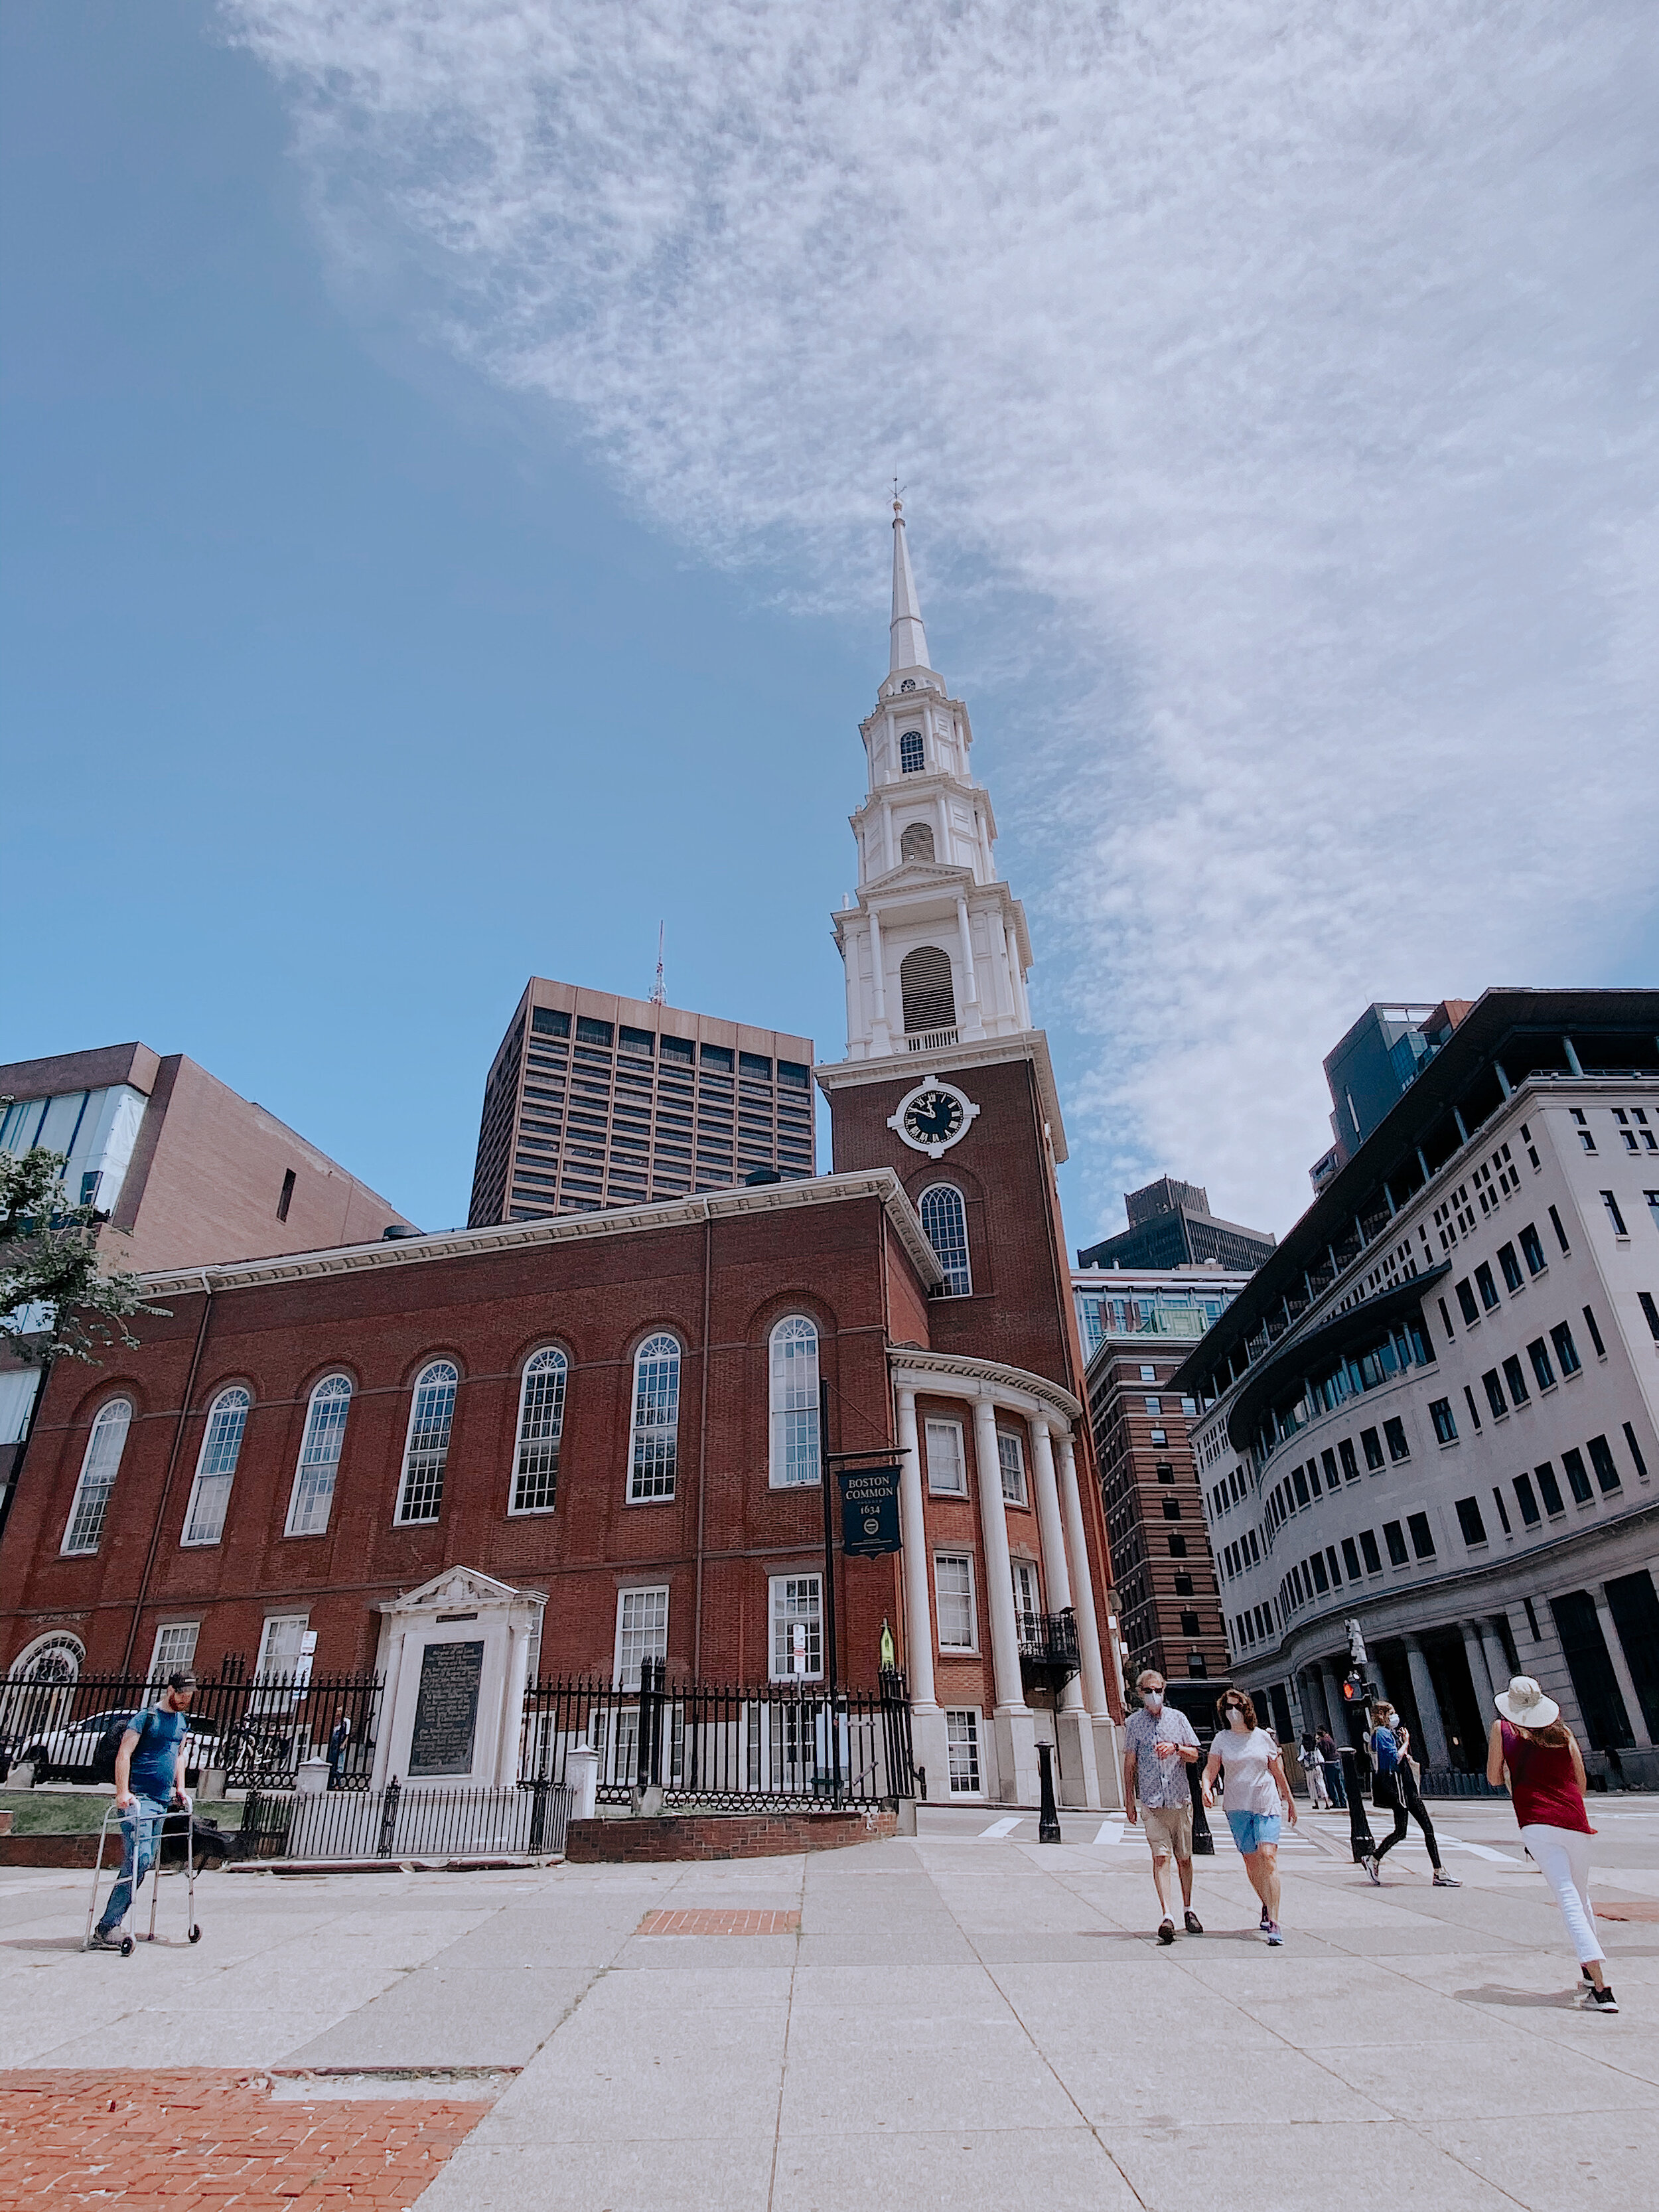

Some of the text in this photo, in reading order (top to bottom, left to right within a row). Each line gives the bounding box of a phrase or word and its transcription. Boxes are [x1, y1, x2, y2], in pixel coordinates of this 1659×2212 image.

[848, 1475, 890, 1489] BOSTON
[845, 1487, 893, 1500] COMMON
[861, 1505, 881, 1515] 1634
